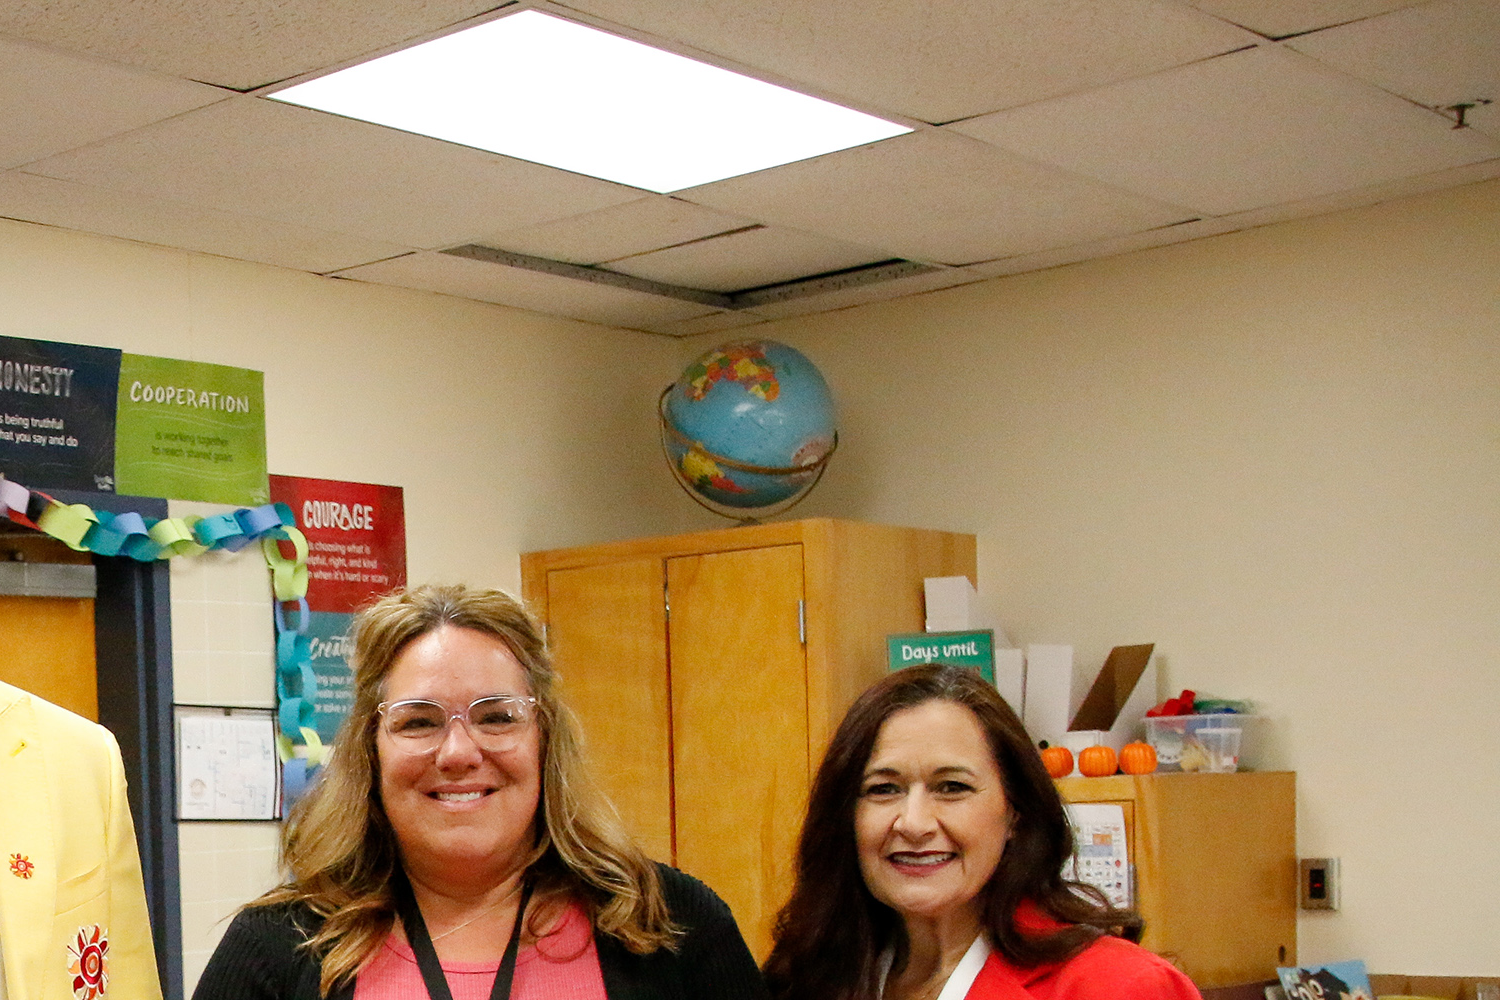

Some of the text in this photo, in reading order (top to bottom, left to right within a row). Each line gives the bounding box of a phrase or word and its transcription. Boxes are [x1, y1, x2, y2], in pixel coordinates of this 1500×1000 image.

[130, 381, 250, 413] COOPERATION
[5, 413, 29, 429] being
[31, 416, 64, 430] truthful
[15, 432, 31, 444] you
[33, 434, 47, 446] say
[48, 435, 65, 446] and
[66, 436, 78, 447] do
[302, 500, 374, 530] COURAGE
[348, 558, 361, 568] and
[310, 636, 351, 661] Creat
[902, 642, 978, 664] Days until
